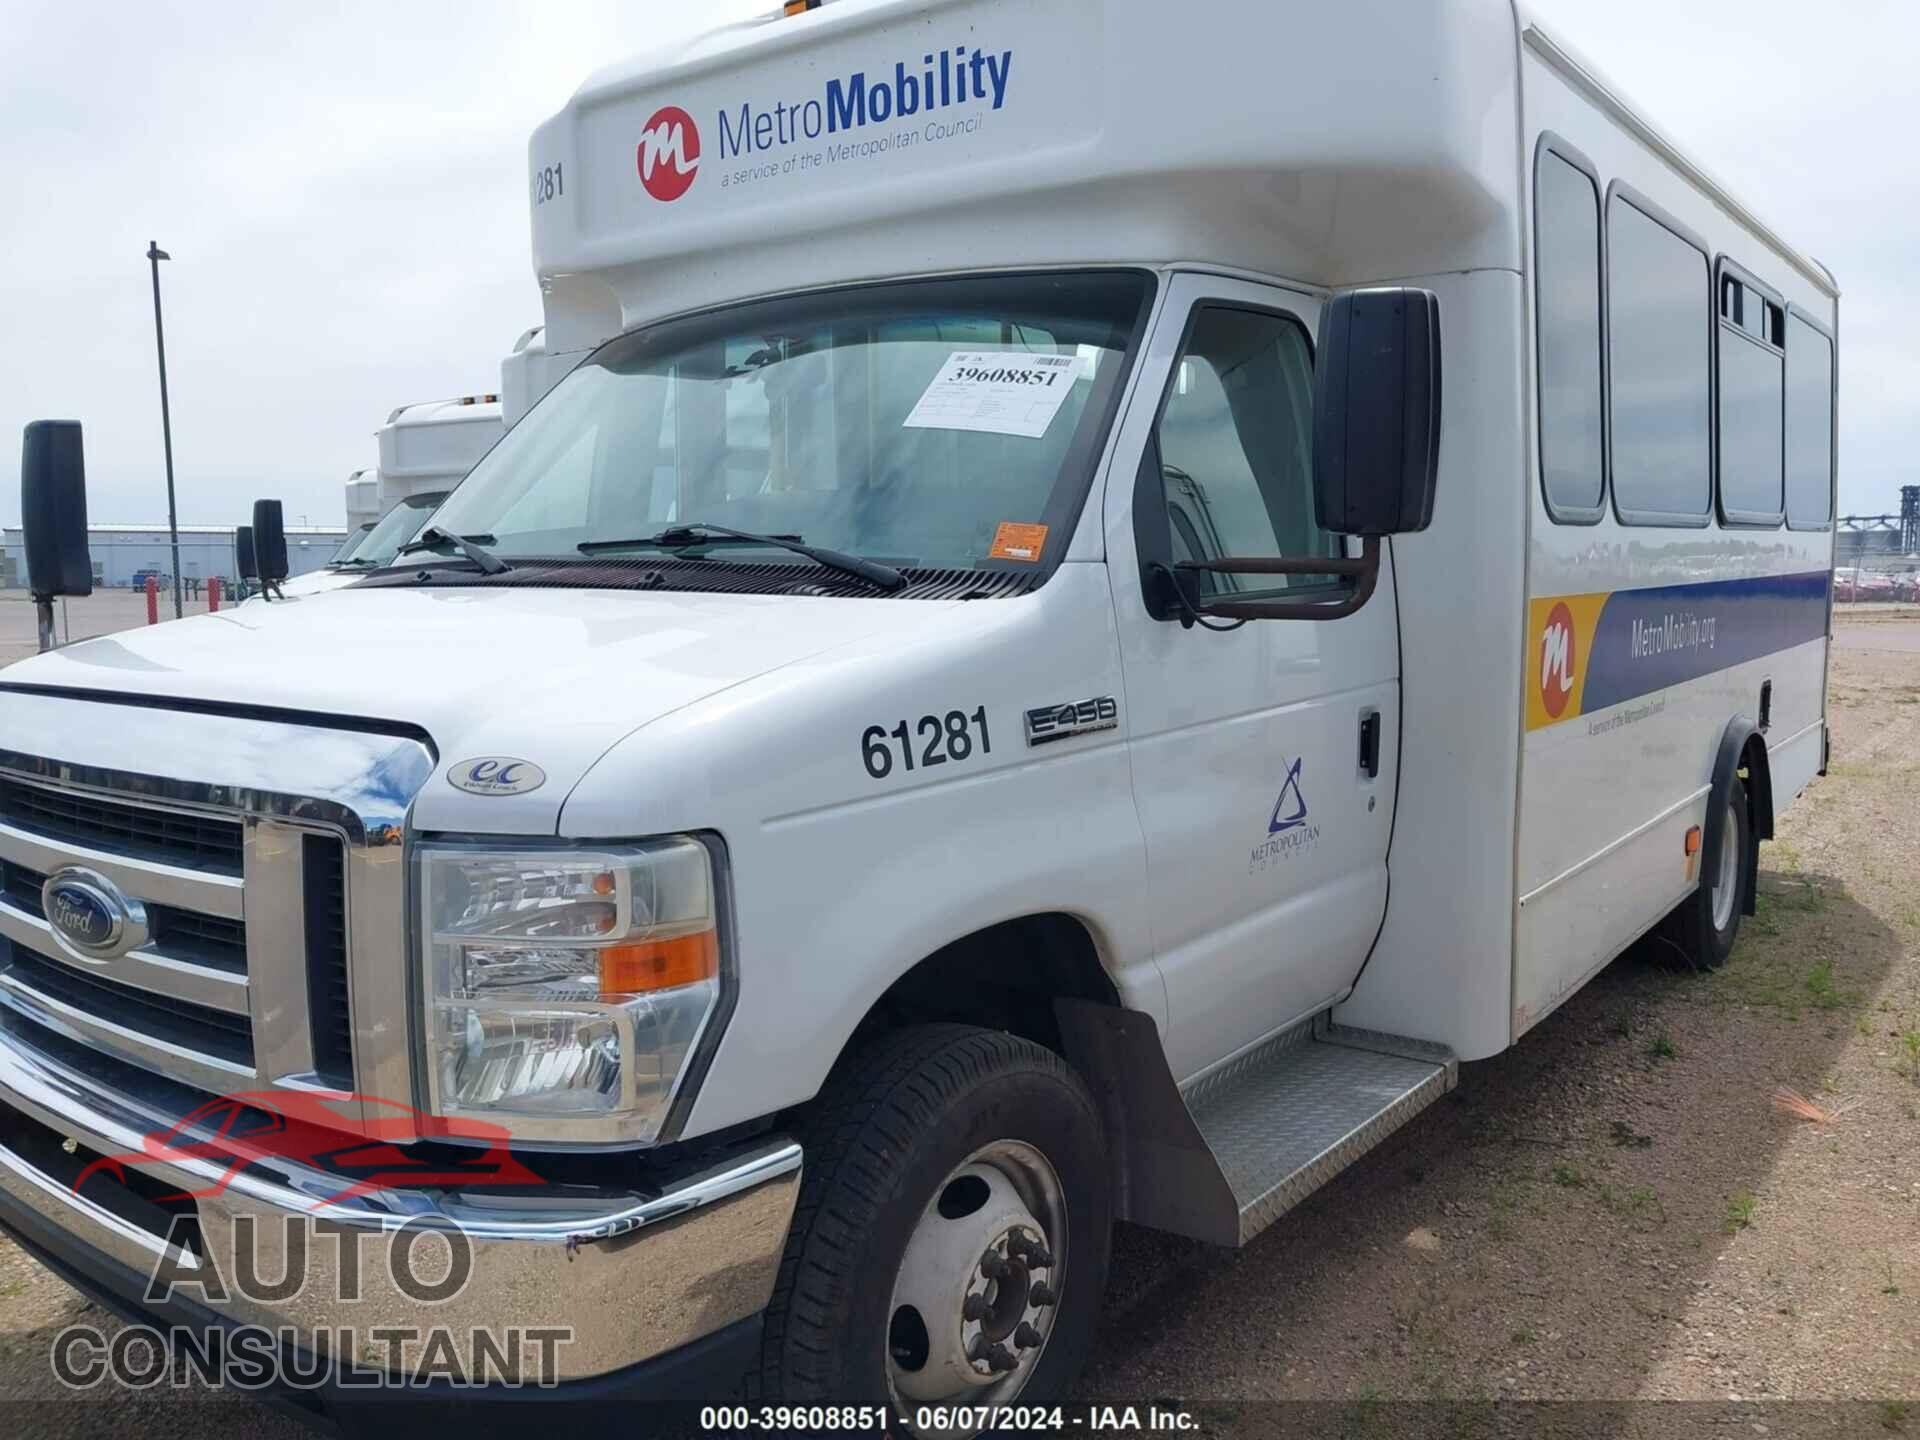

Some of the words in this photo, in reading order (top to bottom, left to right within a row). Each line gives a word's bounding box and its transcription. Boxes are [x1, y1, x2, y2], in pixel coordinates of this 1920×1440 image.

[718, 45, 1012, 160] MetroMobility
[721, 174, 730, 188] a
[732, 161, 779, 185] service
[782, 155, 798, 173] of
[800, 152, 824, 170] the
[826, 129, 920, 164] Metropolitan
[924, 112, 984, 142] Council
[948, 367, 1059, 387] 39608851
[1631, 611, 1717, 659] MetroMobility.org
[861, 704, 992, 780] 61281
[55, 891, 94, 934] Ford
